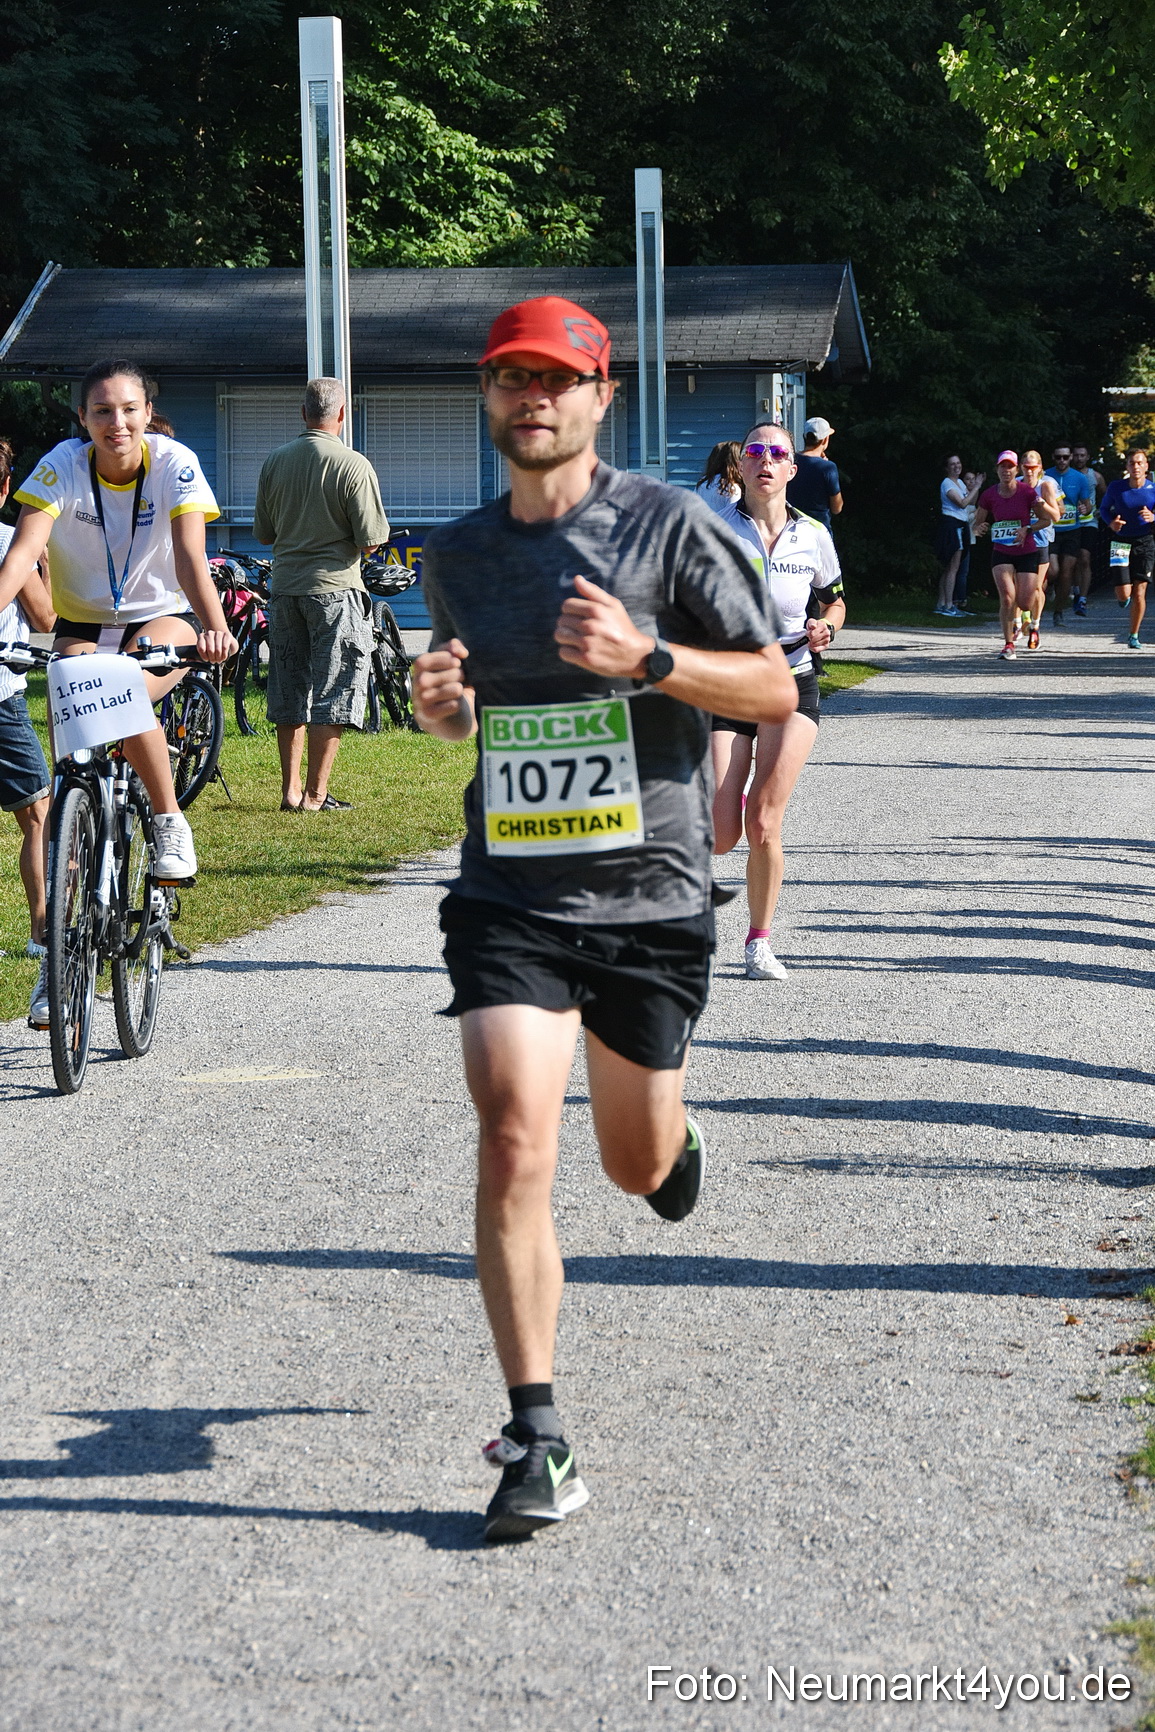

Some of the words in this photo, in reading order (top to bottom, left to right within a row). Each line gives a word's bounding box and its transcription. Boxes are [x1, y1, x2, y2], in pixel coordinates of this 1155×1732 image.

[32, 464, 59, 487] 20
[56, 677, 103, 699] 1.Frau
[53, 707, 71, 726] 0,5
[73, 701, 98, 717] km
[100, 689, 133, 709] Lauf
[489, 707, 617, 747] BOCK
[499, 755, 615, 803] 1072
[497, 812, 623, 837] CHRISTIAN
